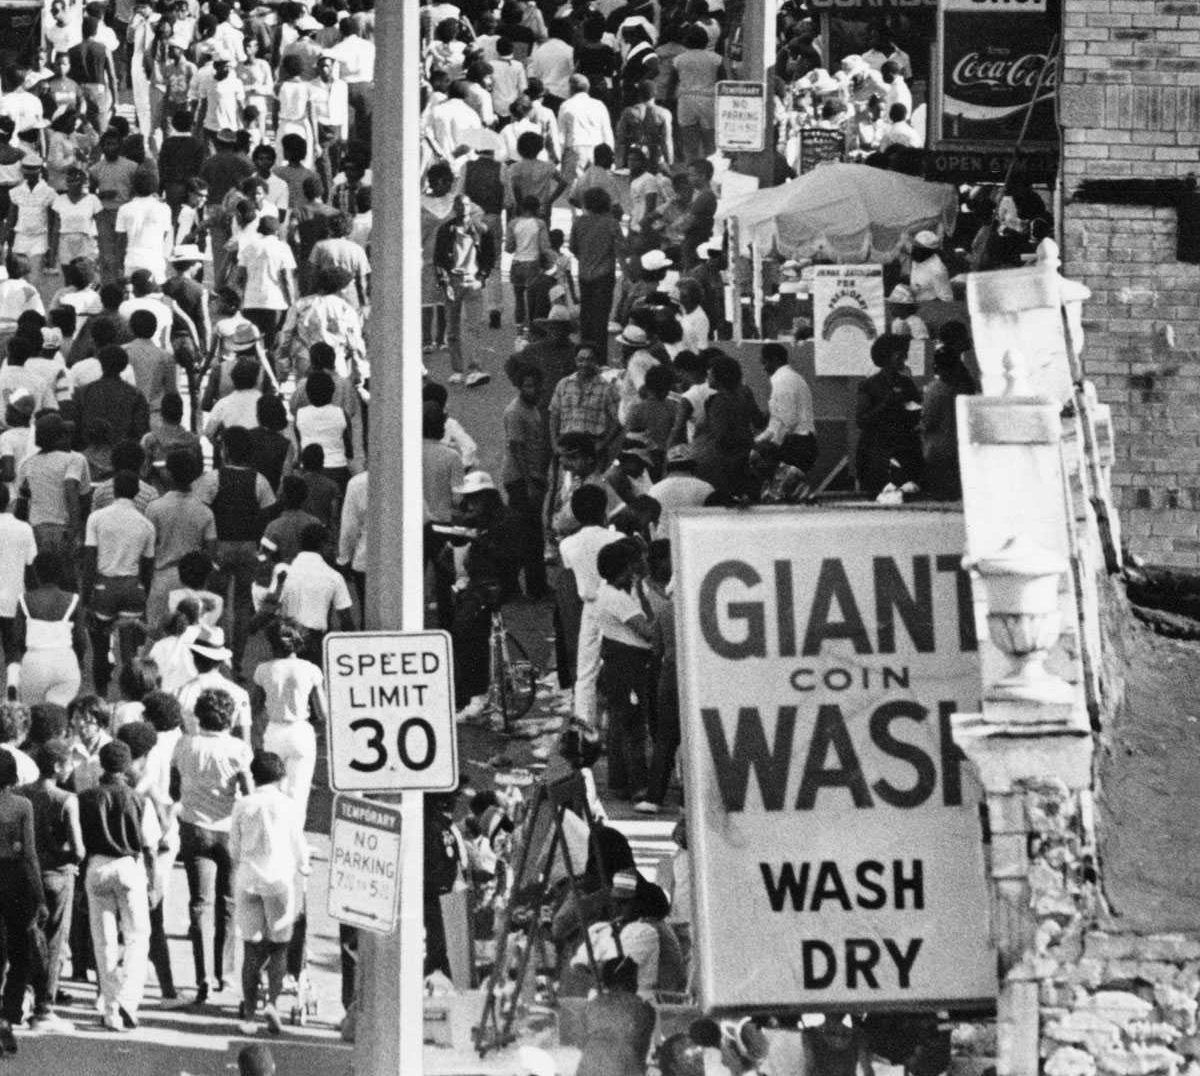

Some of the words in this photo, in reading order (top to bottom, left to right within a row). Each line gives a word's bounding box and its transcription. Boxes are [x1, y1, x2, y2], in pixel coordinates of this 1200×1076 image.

[732, 98, 749, 109] NO
[936, 156, 982, 171] OPEN
[700, 554, 979, 661] GIANT
[336, 652, 440, 676] SPEED
[789, 666, 911, 692] COIN
[349, 685, 429, 709] LIMIT
[348, 717, 437, 773] 30
[341, 802, 397, 829] TEMPORARY
[353, 830, 379, 852] NO
[335, 846, 395, 880] PARKING
[759, 859, 925, 912] WASH
[801, 938, 924, 991] DRY
